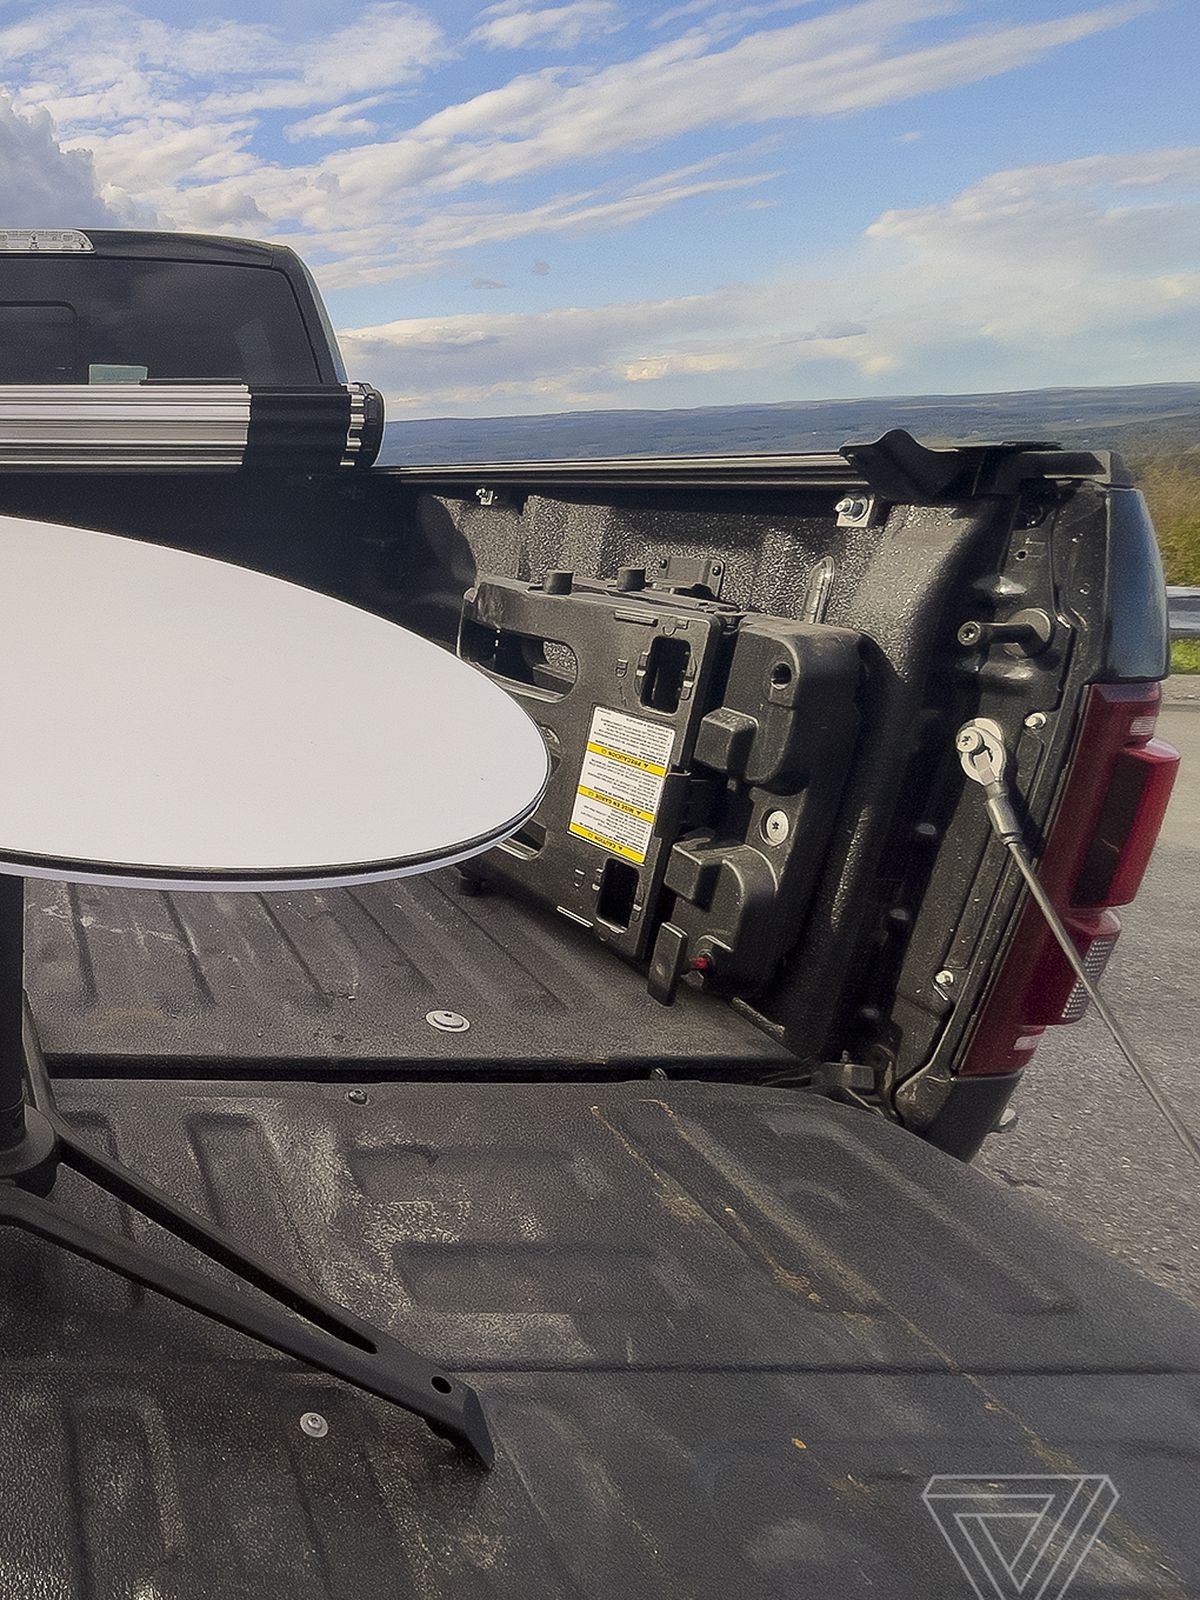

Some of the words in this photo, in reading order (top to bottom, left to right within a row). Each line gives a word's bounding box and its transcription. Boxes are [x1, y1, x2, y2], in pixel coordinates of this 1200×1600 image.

[594, 793, 612, 804] GARDE
[612, 800, 620, 808] EN
[620, 803, 634, 813] MISE
[593, 834, 616, 849] CAUTION
